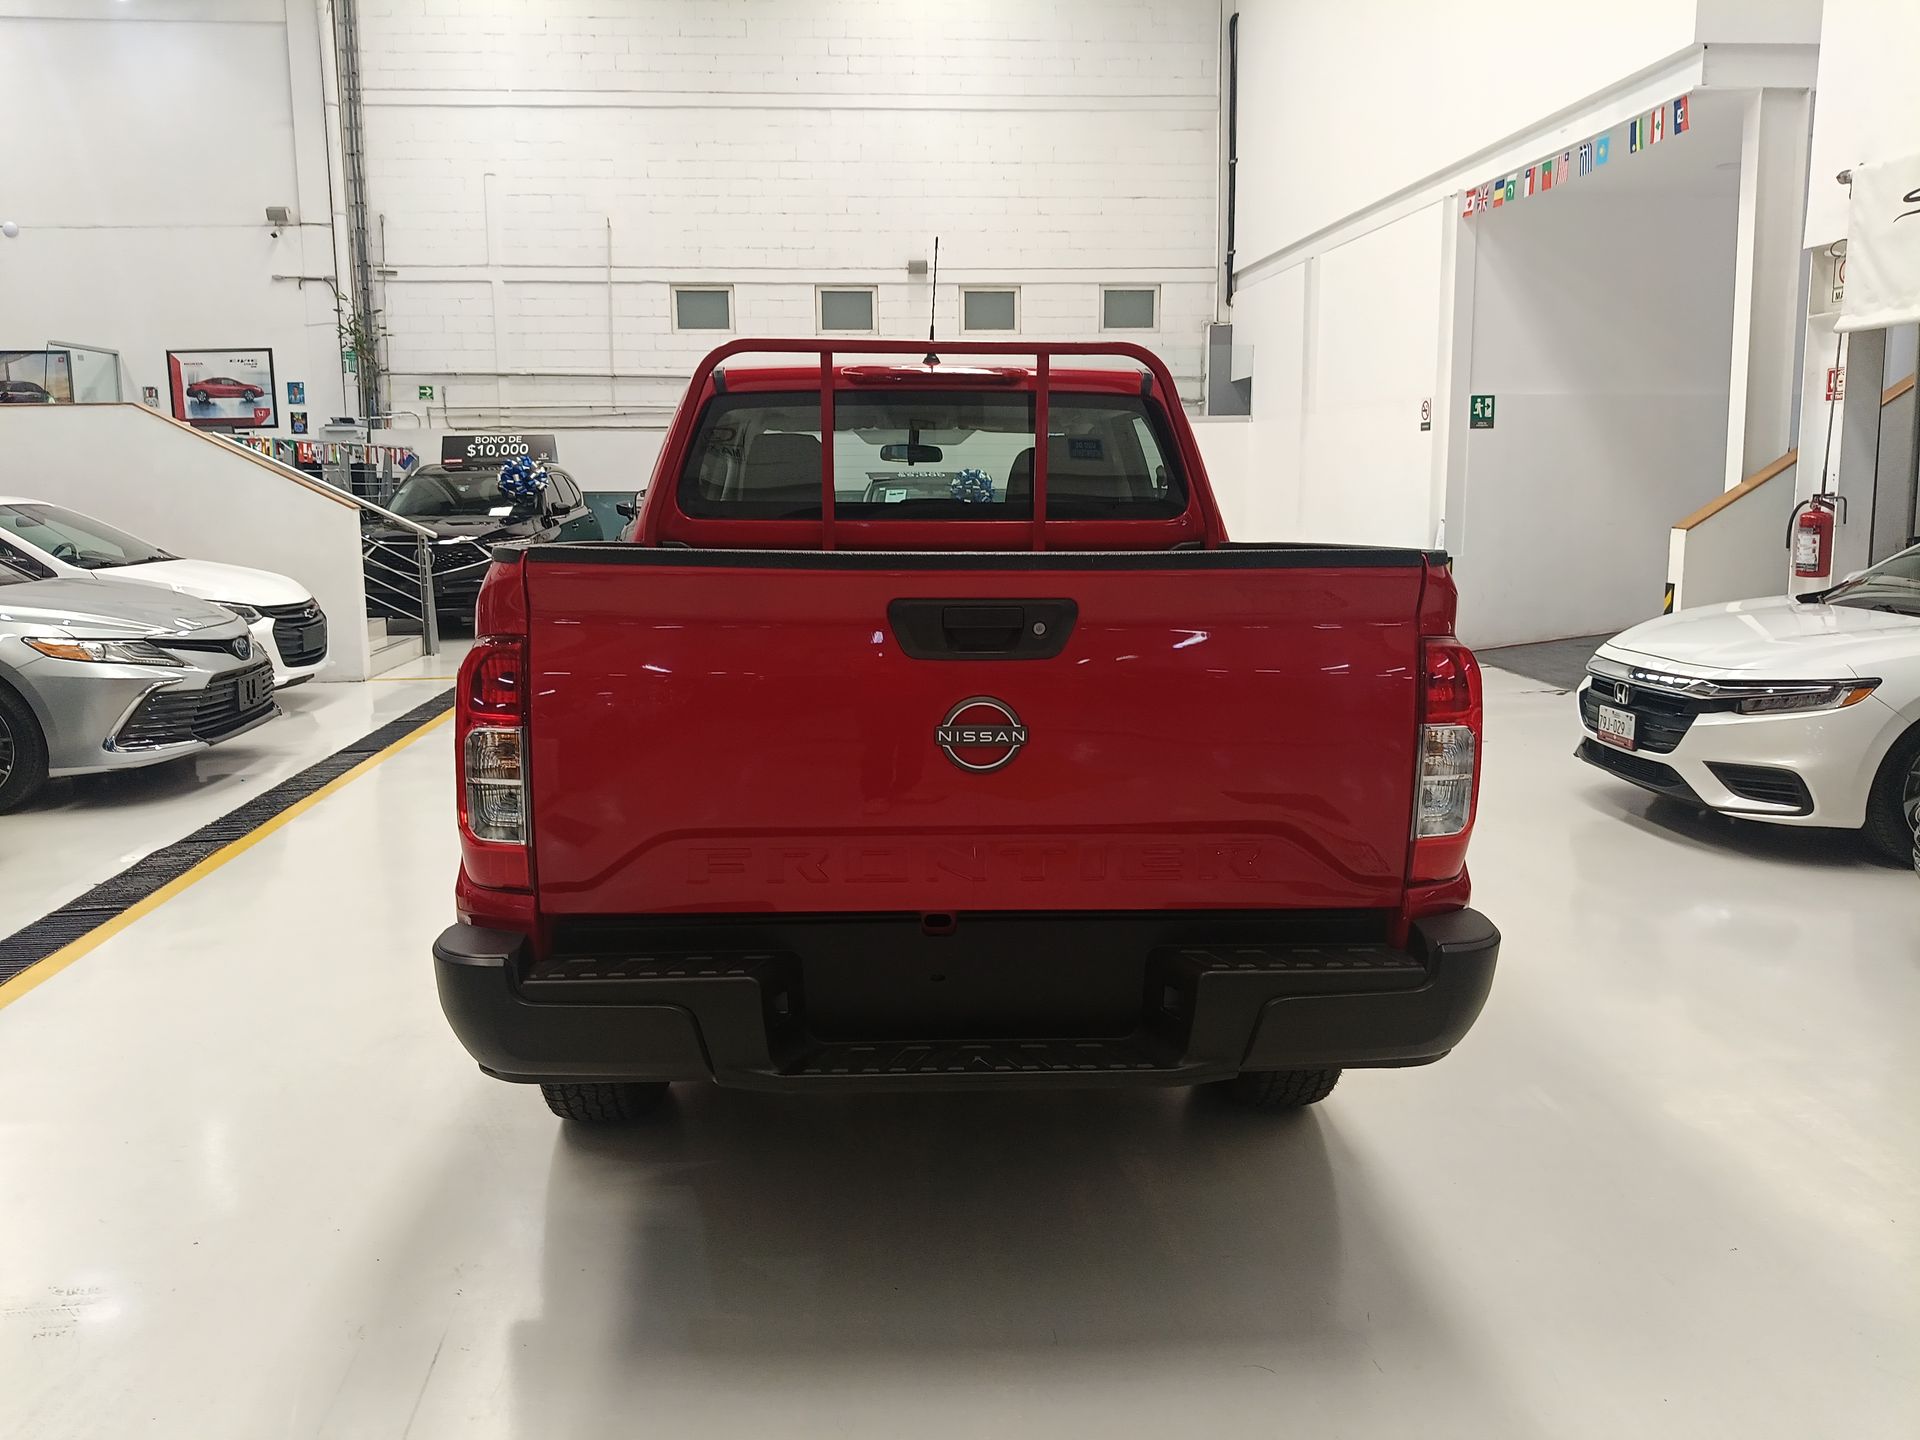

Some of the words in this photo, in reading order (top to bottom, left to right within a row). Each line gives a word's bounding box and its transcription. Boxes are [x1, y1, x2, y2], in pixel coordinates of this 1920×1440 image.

[475, 436, 506, 444] BONO
[466, 443, 529, 457] $10,000
[938, 730, 1025, 742] NISSAN
[685, 843, 1264, 884] FRONTIER
